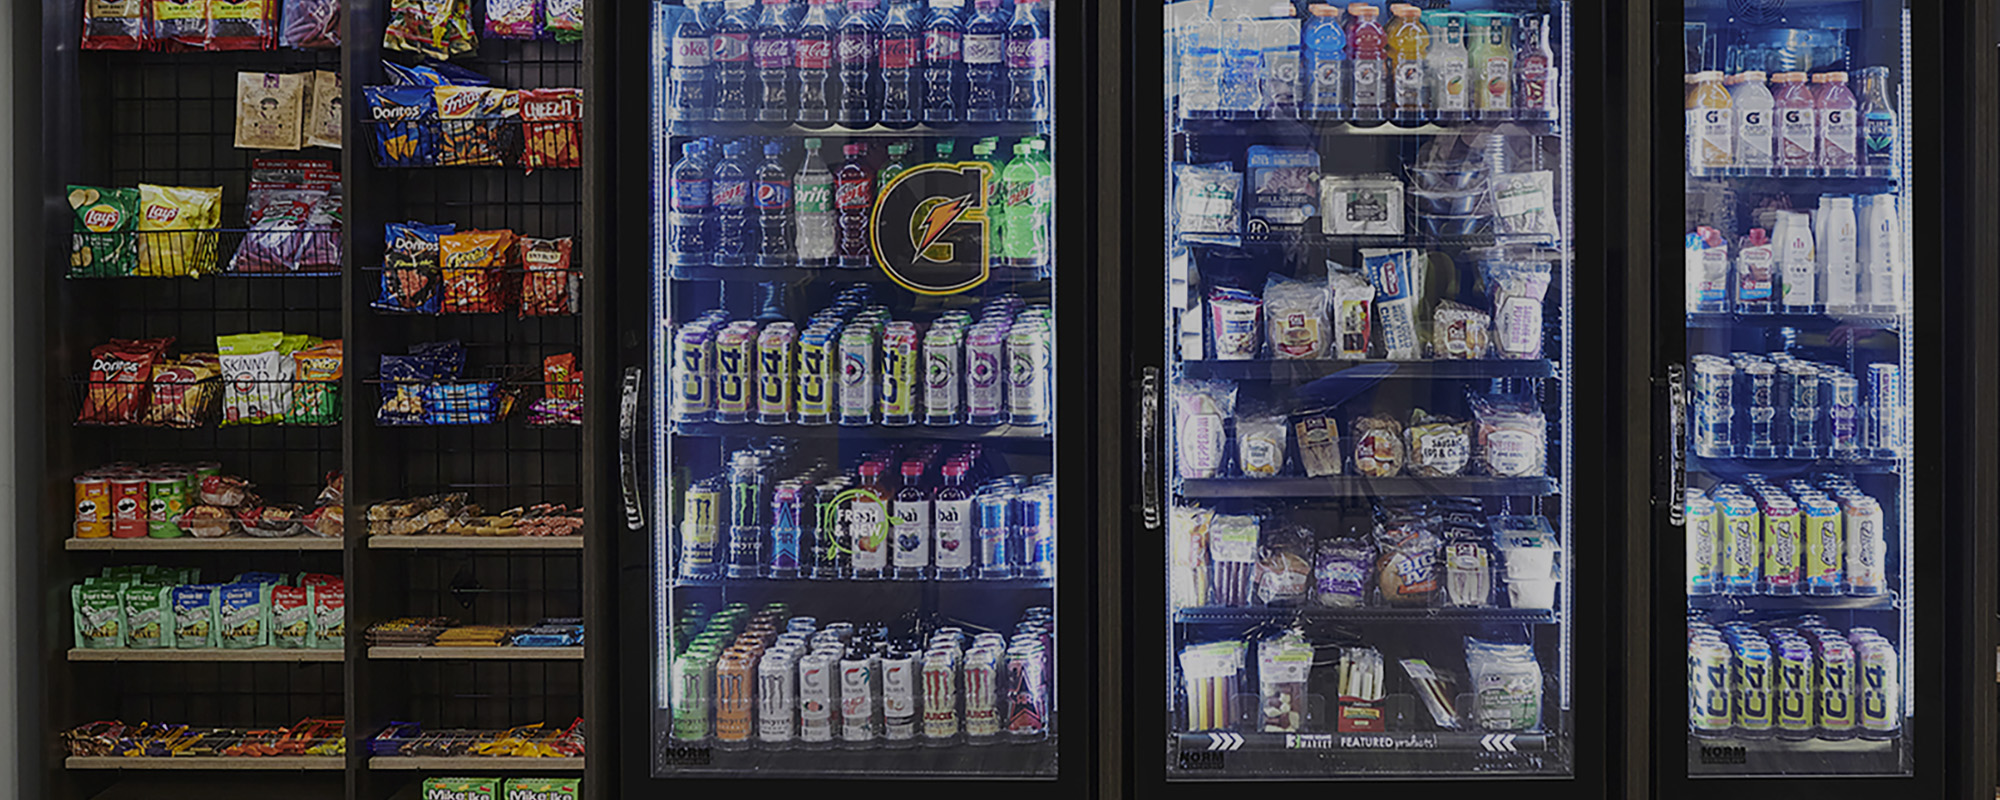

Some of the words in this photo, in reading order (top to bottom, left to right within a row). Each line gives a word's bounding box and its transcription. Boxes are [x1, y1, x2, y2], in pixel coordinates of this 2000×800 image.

[676, 42, 707, 56] oke
[443, 91, 480, 113] Fritos
[372, 105, 420, 119] Doritos
[1706, 110, 1718, 124] G
[1746, 111, 1760, 125] G
[1786, 110, 1800, 123] G
[1828, 110, 1841, 124] G
[87, 210, 116, 228] Lay's
[147, 205, 179, 222] Lay's
[870, 162, 993, 296] G
[395, 236, 440, 252] Doritos
[1380, 306, 1397, 351] CHEESE
[92, 358, 140, 374] Doritos
[223, 355, 270, 371] SKINNY
[682, 348, 702, 401] C4
[720, 348, 742, 402] C4
[761, 349, 782, 404] C4
[804, 348, 824, 403] C4
[897, 508, 918, 523] bai
[937, 507, 959, 522] bai
[1397, 552, 1436, 575] BIG
[1405, 565, 1433, 585] AZ
[1707, 664, 1728, 718] C4
[1744, 665, 1767, 718] C4
[1783, 664, 1804, 718] C4
[1825, 664, 1847, 718] C4
[1865, 665, 1887, 719] C4
[924, 711, 953, 721] JUICE
[965, 710, 993, 719] JUICE
[1340, 736, 1393, 748] FEATURED
[666, 747, 710, 758] NORM
[1180, 752, 1224, 763] NORM
[1702, 747, 1746, 757] NORM
